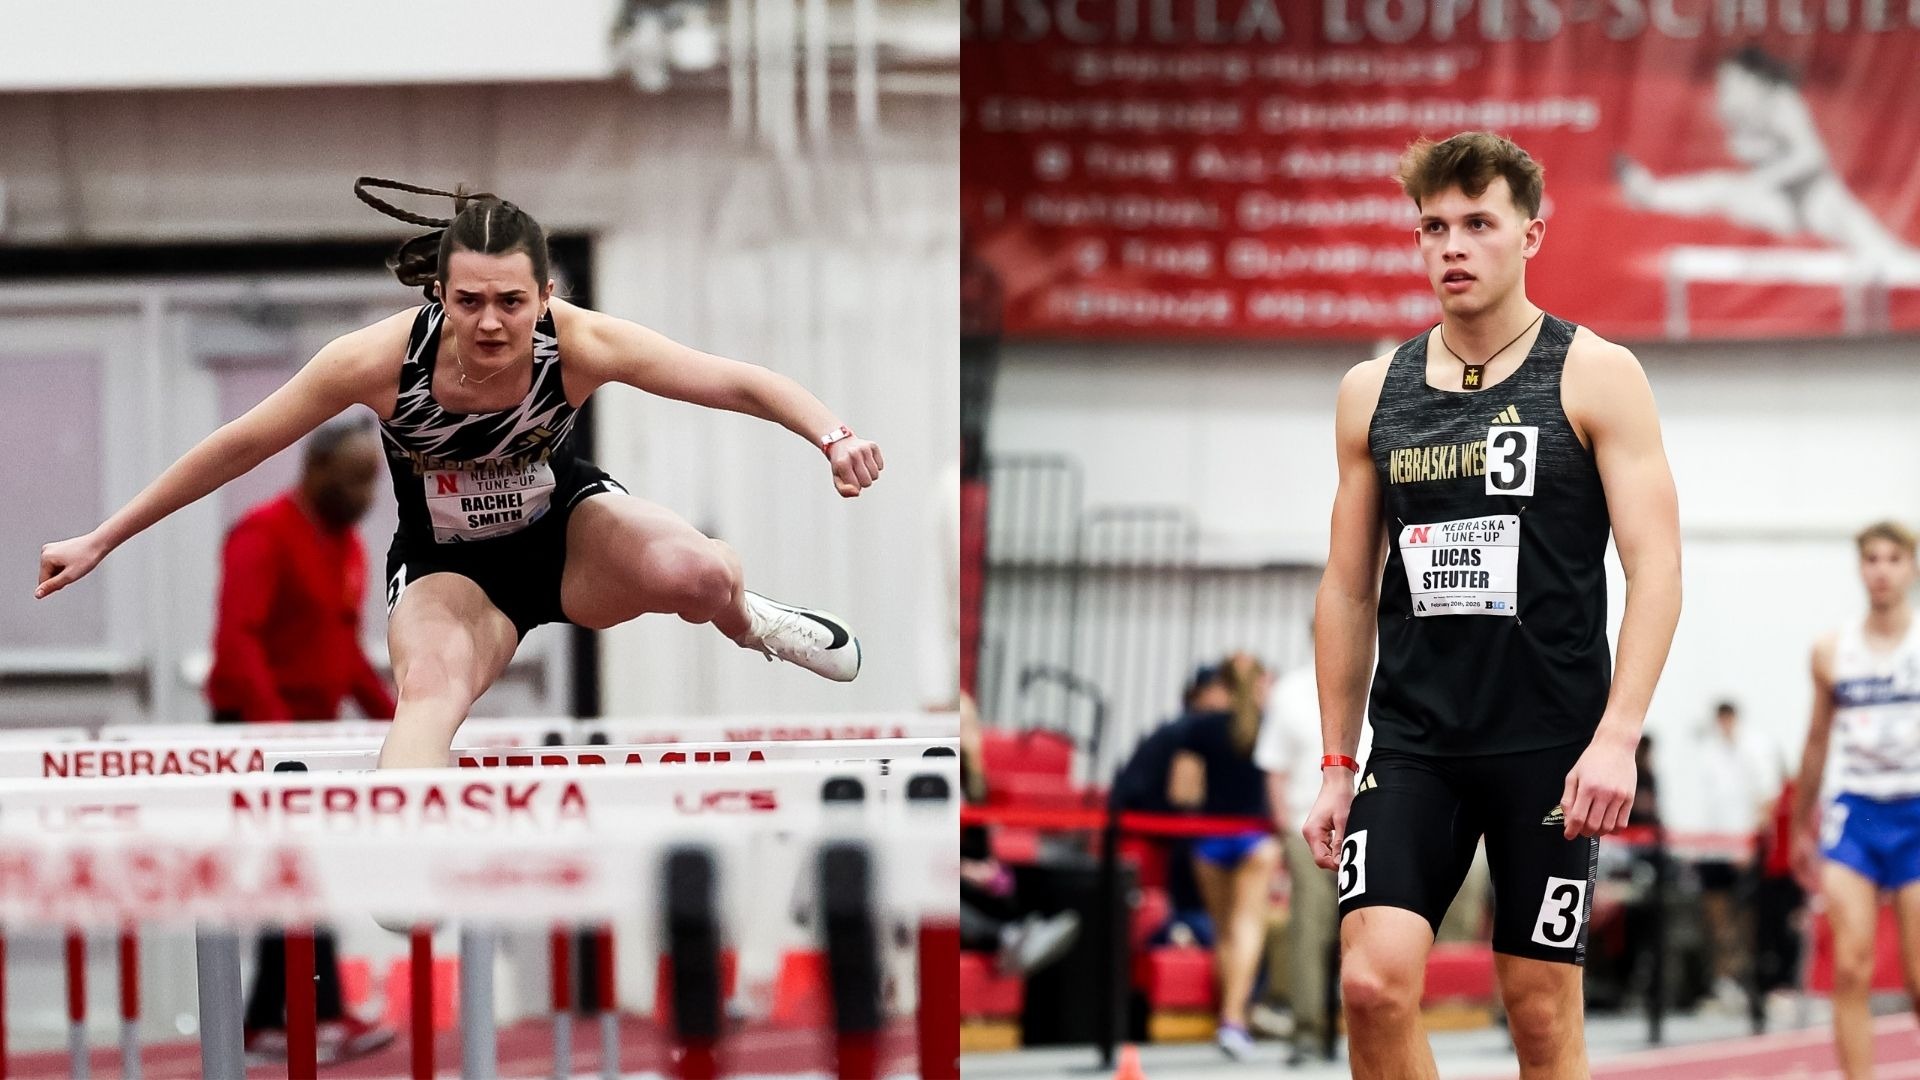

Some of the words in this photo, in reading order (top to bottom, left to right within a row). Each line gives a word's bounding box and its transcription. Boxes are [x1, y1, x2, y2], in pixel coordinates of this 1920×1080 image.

[960, 0, 1284, 41] ISCILLA
[1390, 444, 1456, 484] NEBRASKA
[1490, 430, 1528, 490] 3
[436, 474, 458, 495] N
[477, 475, 536, 491] TUNE-UP
[460, 493, 524, 513] RACHEL
[467, 509, 523, 529] SMITH
[1442, 519, 1505, 532] NEBRASKA
[1409, 526, 1432, 544] N
[1445, 532, 1500, 543] TUNE-UP
[1431, 548, 1481, 567] LUCAS
[1423, 571, 1490, 589] STEUTER
[43, 749, 265, 778] NEBRASKA
[231, 782, 590, 826] NEBRASKA
[1339, 839, 1358, 894] 3
[1542, 884, 1580, 942] 3
